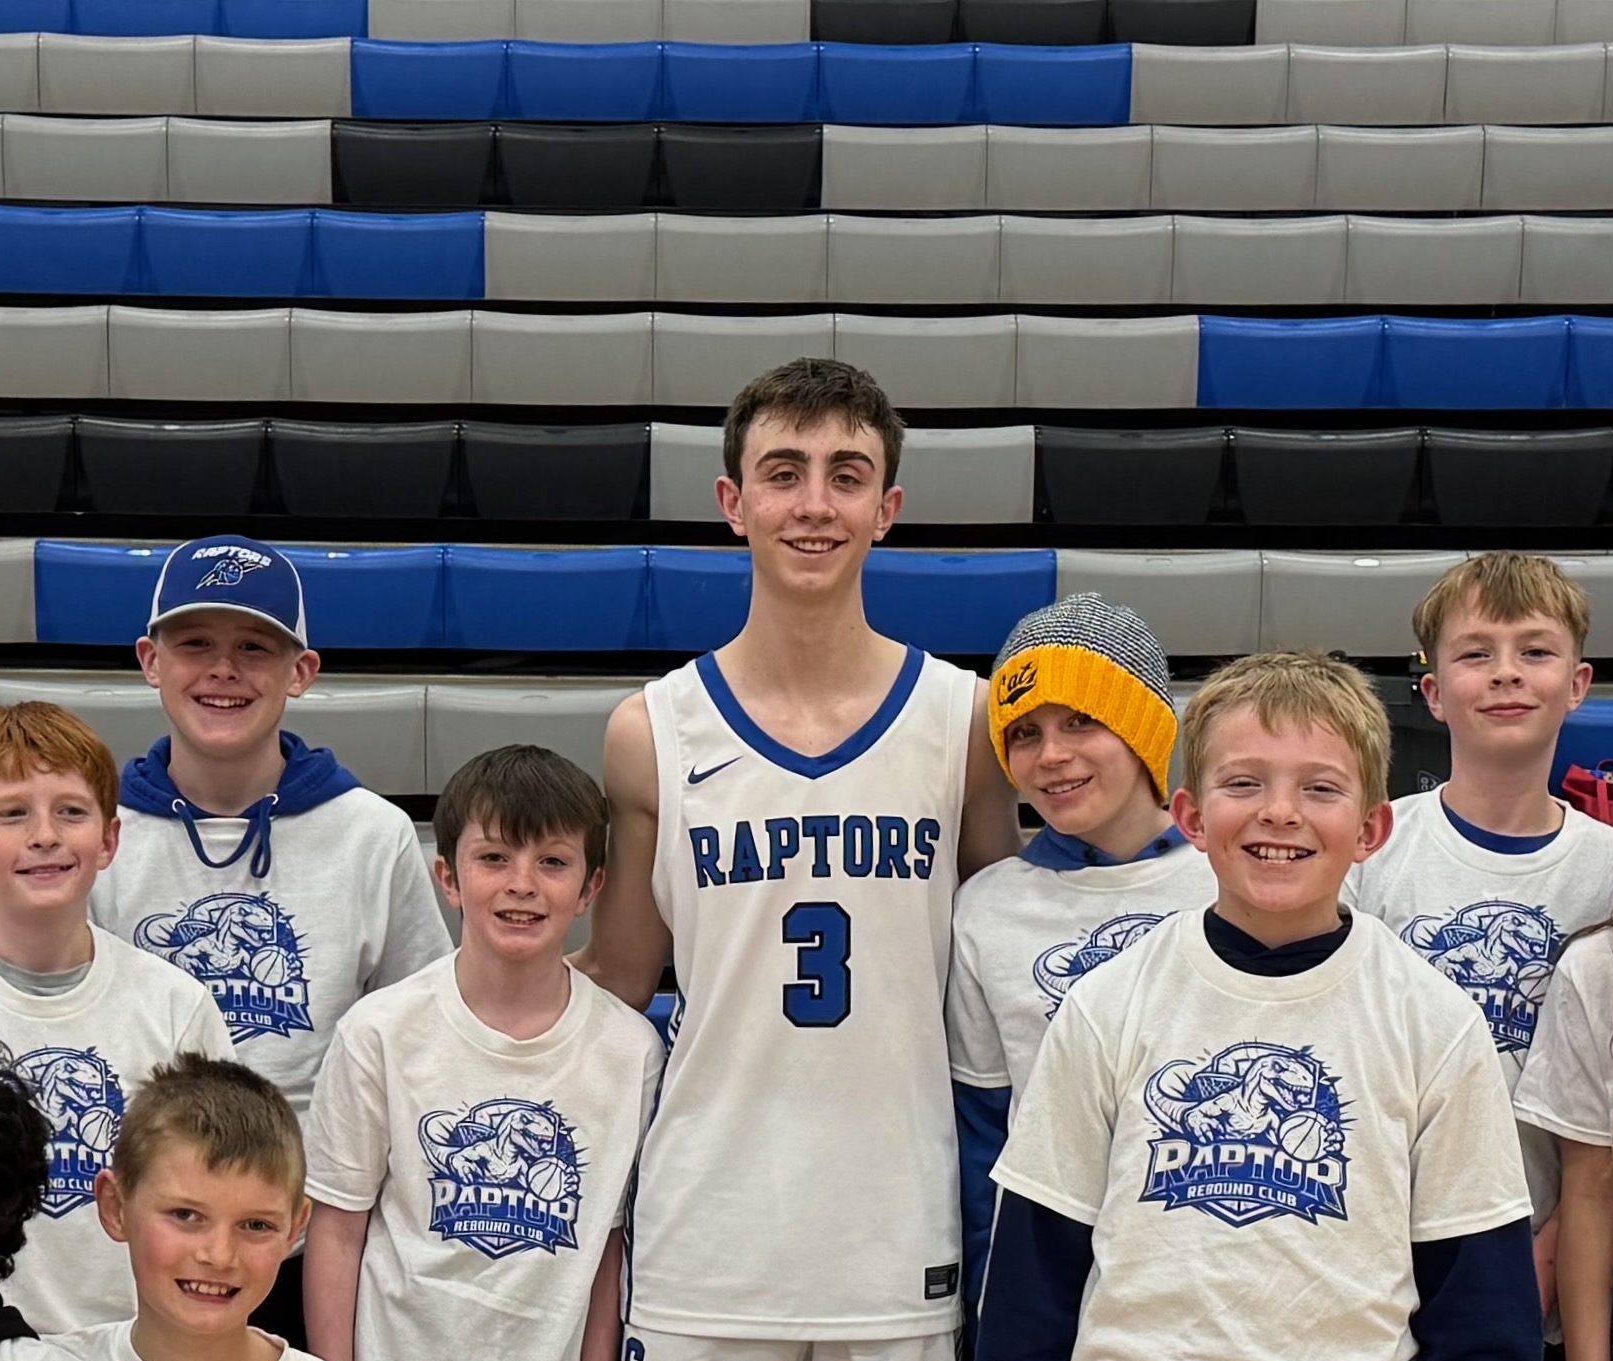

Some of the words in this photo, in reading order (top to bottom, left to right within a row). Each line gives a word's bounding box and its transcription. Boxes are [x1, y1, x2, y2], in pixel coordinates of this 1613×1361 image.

[191, 546, 272, 567] RAPTORS
[689, 815, 940, 888] RAPTORS
[782, 901, 851, 1028] 3
[240, 1012, 273, 1026] CLUB
[1499, 1022, 1530, 1042] CLUB
[68, 1177, 95, 1191] CLU
[1149, 1140, 1344, 1214] RAPTOR
[1187, 1182, 1254, 1199] REBOUND
[1258, 1185, 1297, 1207] CLUB
[432, 1180, 575, 1244] RAPTOR
[453, 1219, 511, 1234] REBOUND
[513, 1225, 544, 1241] CLUB
